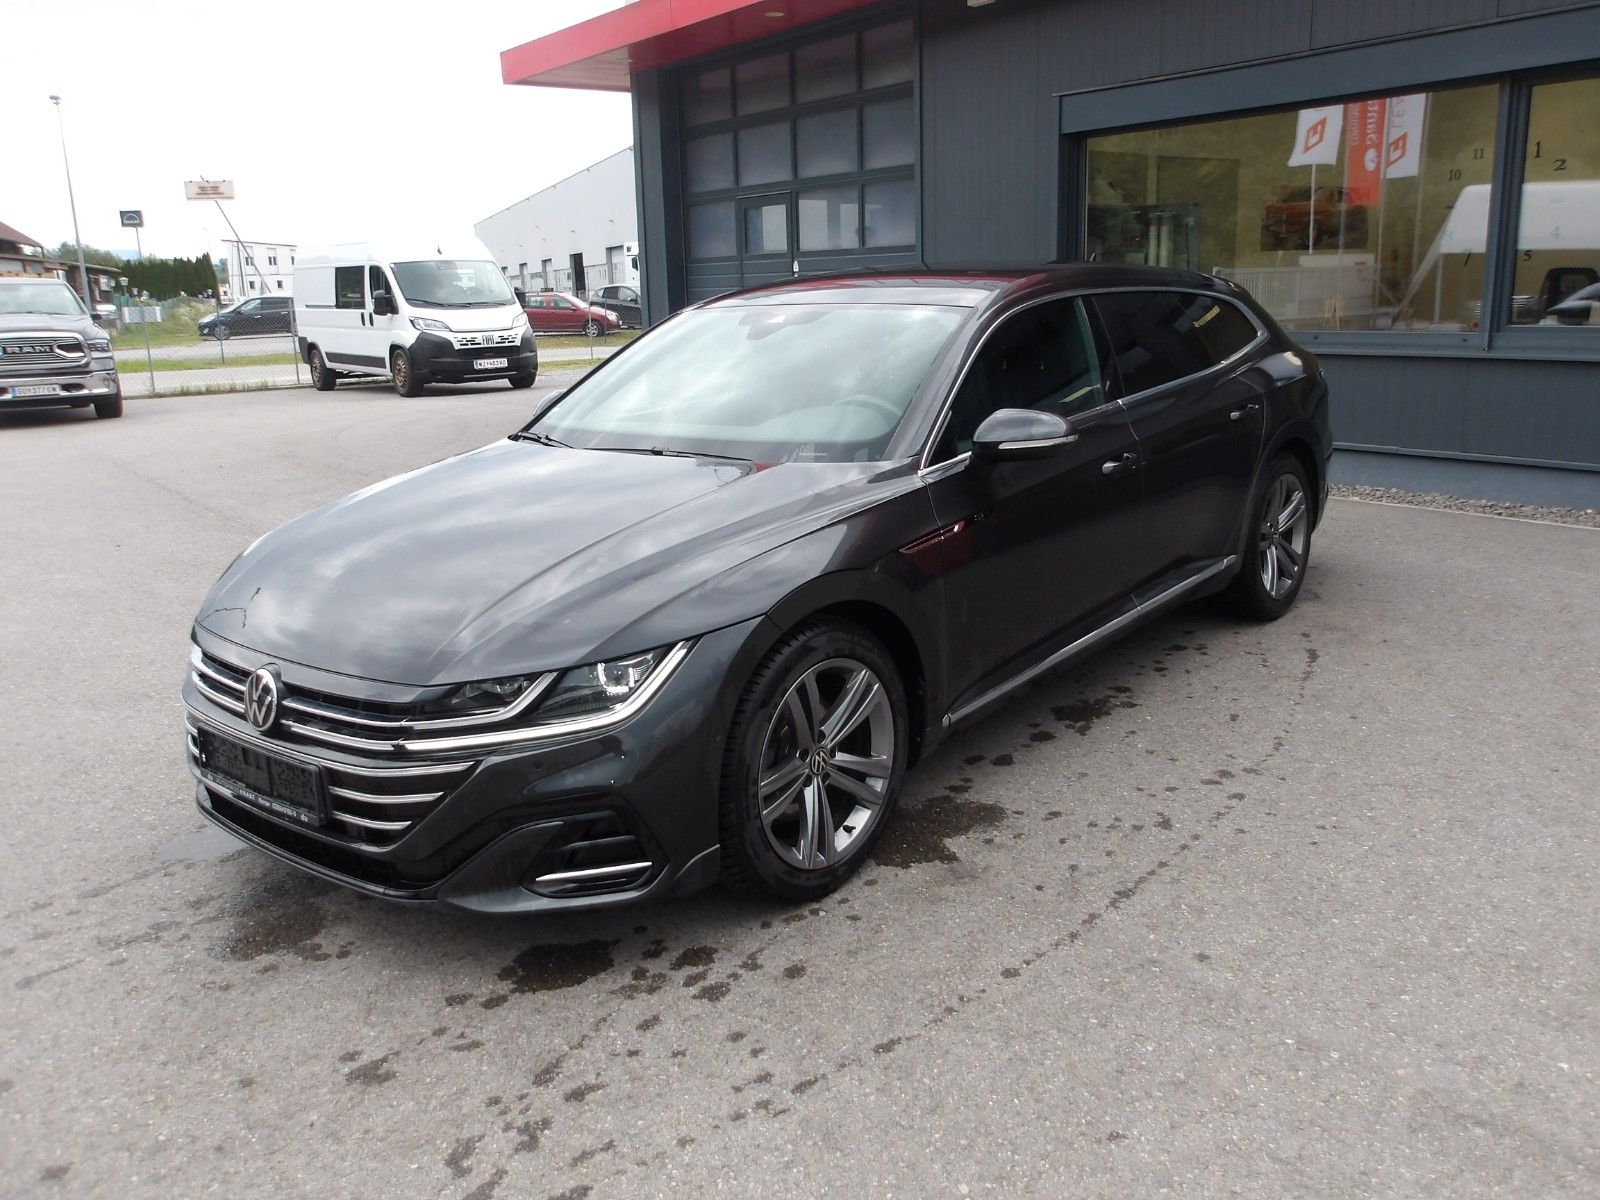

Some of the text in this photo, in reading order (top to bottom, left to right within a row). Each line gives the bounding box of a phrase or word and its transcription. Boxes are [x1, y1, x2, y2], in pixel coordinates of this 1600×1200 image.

[1473, 148, 1484, 160] 11
[1534, 141, 1542, 158] 1
[1553, 159, 1567, 171] 2
[1449, 169, 1461, 181] 10
[1522, 249, 1532, 261] 5
[482, 335, 495, 345] FIAT
[6, 345, 51, 354] RAM
